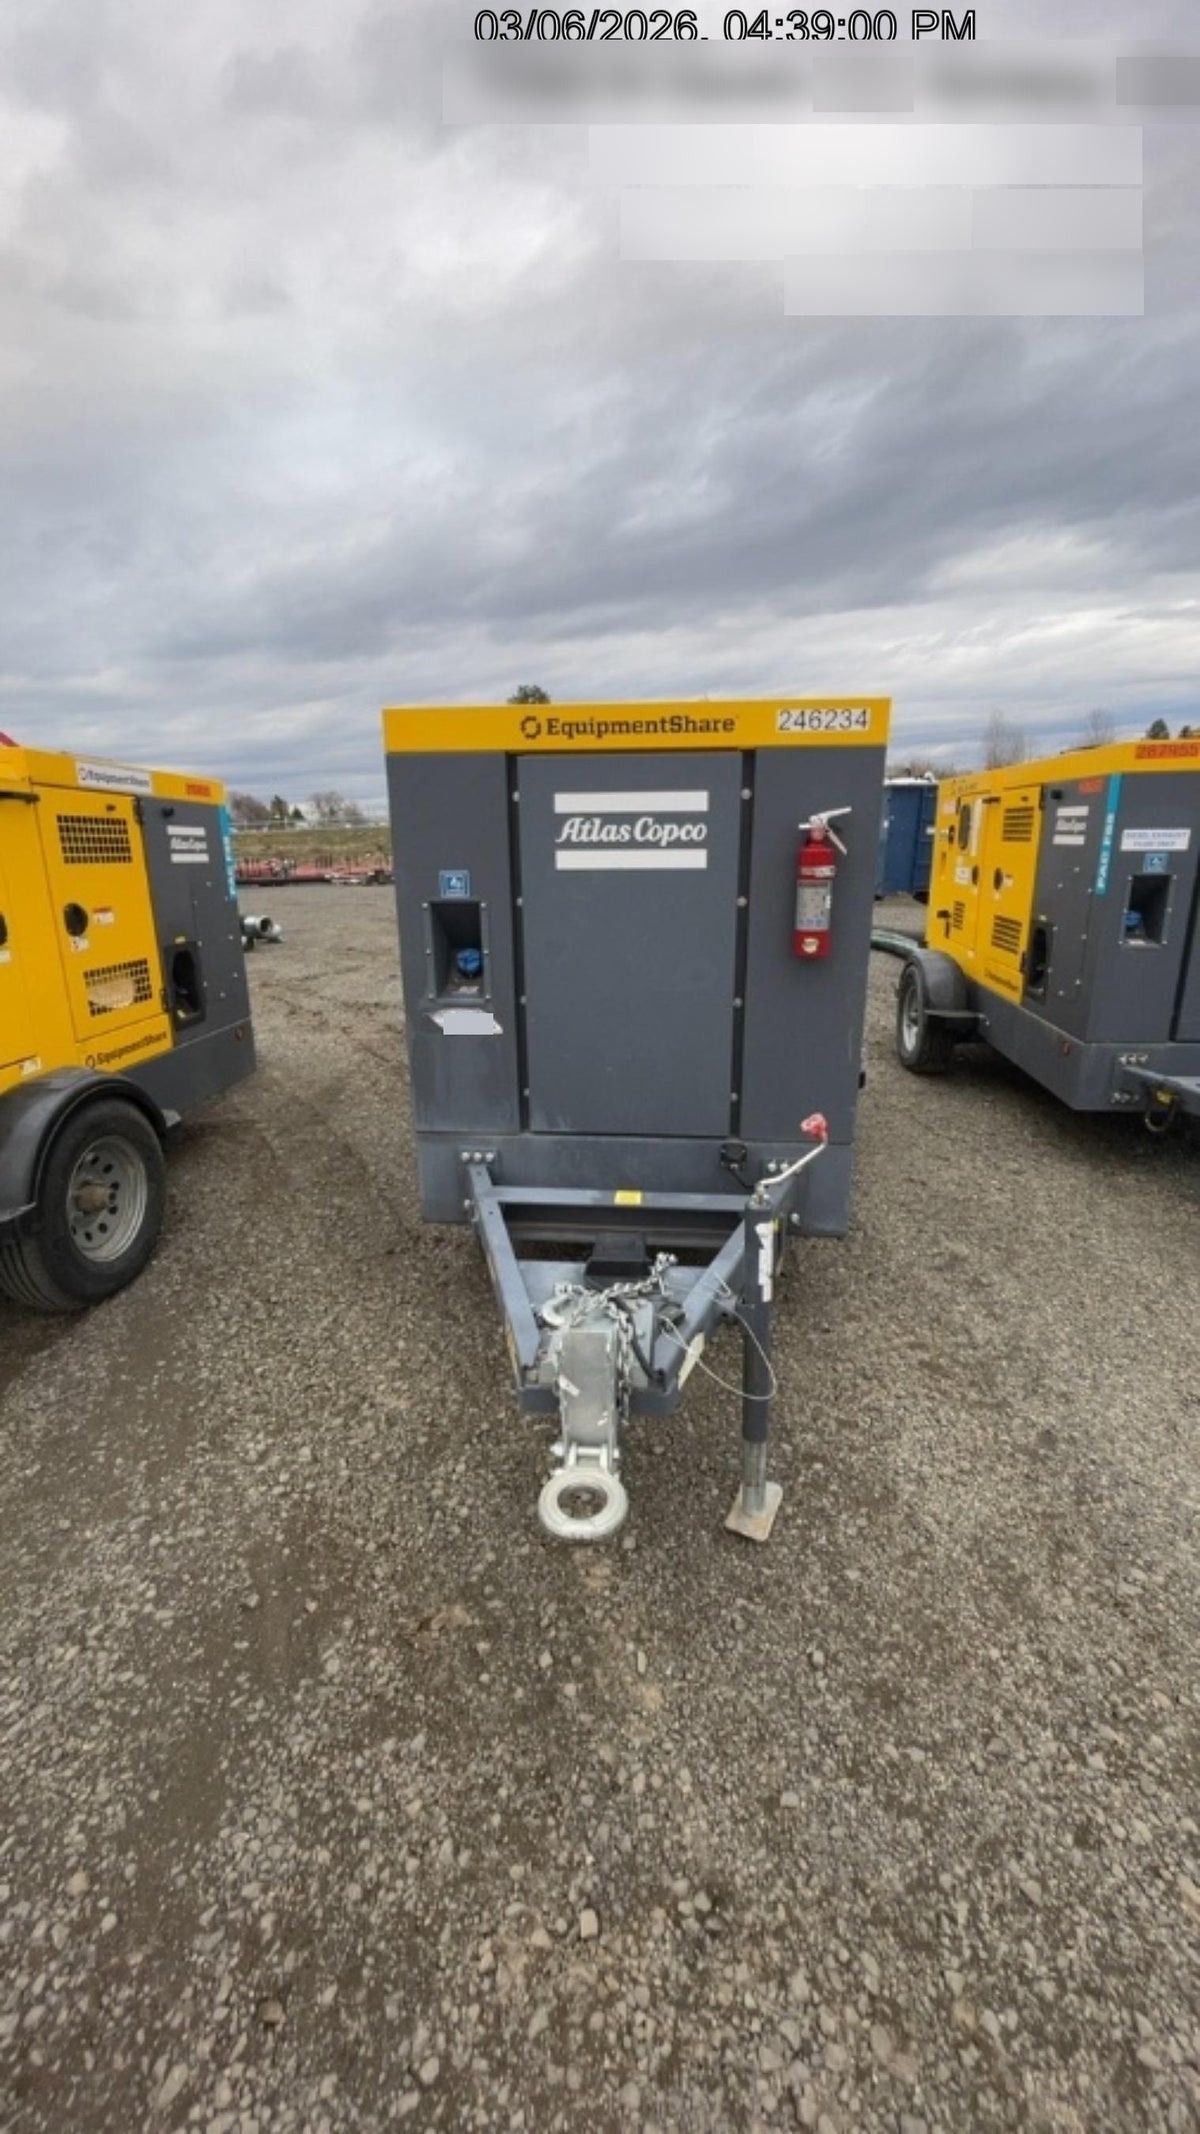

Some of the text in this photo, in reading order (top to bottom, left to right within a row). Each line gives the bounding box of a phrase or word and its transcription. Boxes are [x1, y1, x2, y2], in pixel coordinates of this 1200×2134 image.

[546, 715, 736, 739] EquipmentShare
[778, 708, 869, 731] 246234
[555, 817, 707, 847] Atlas Copco
